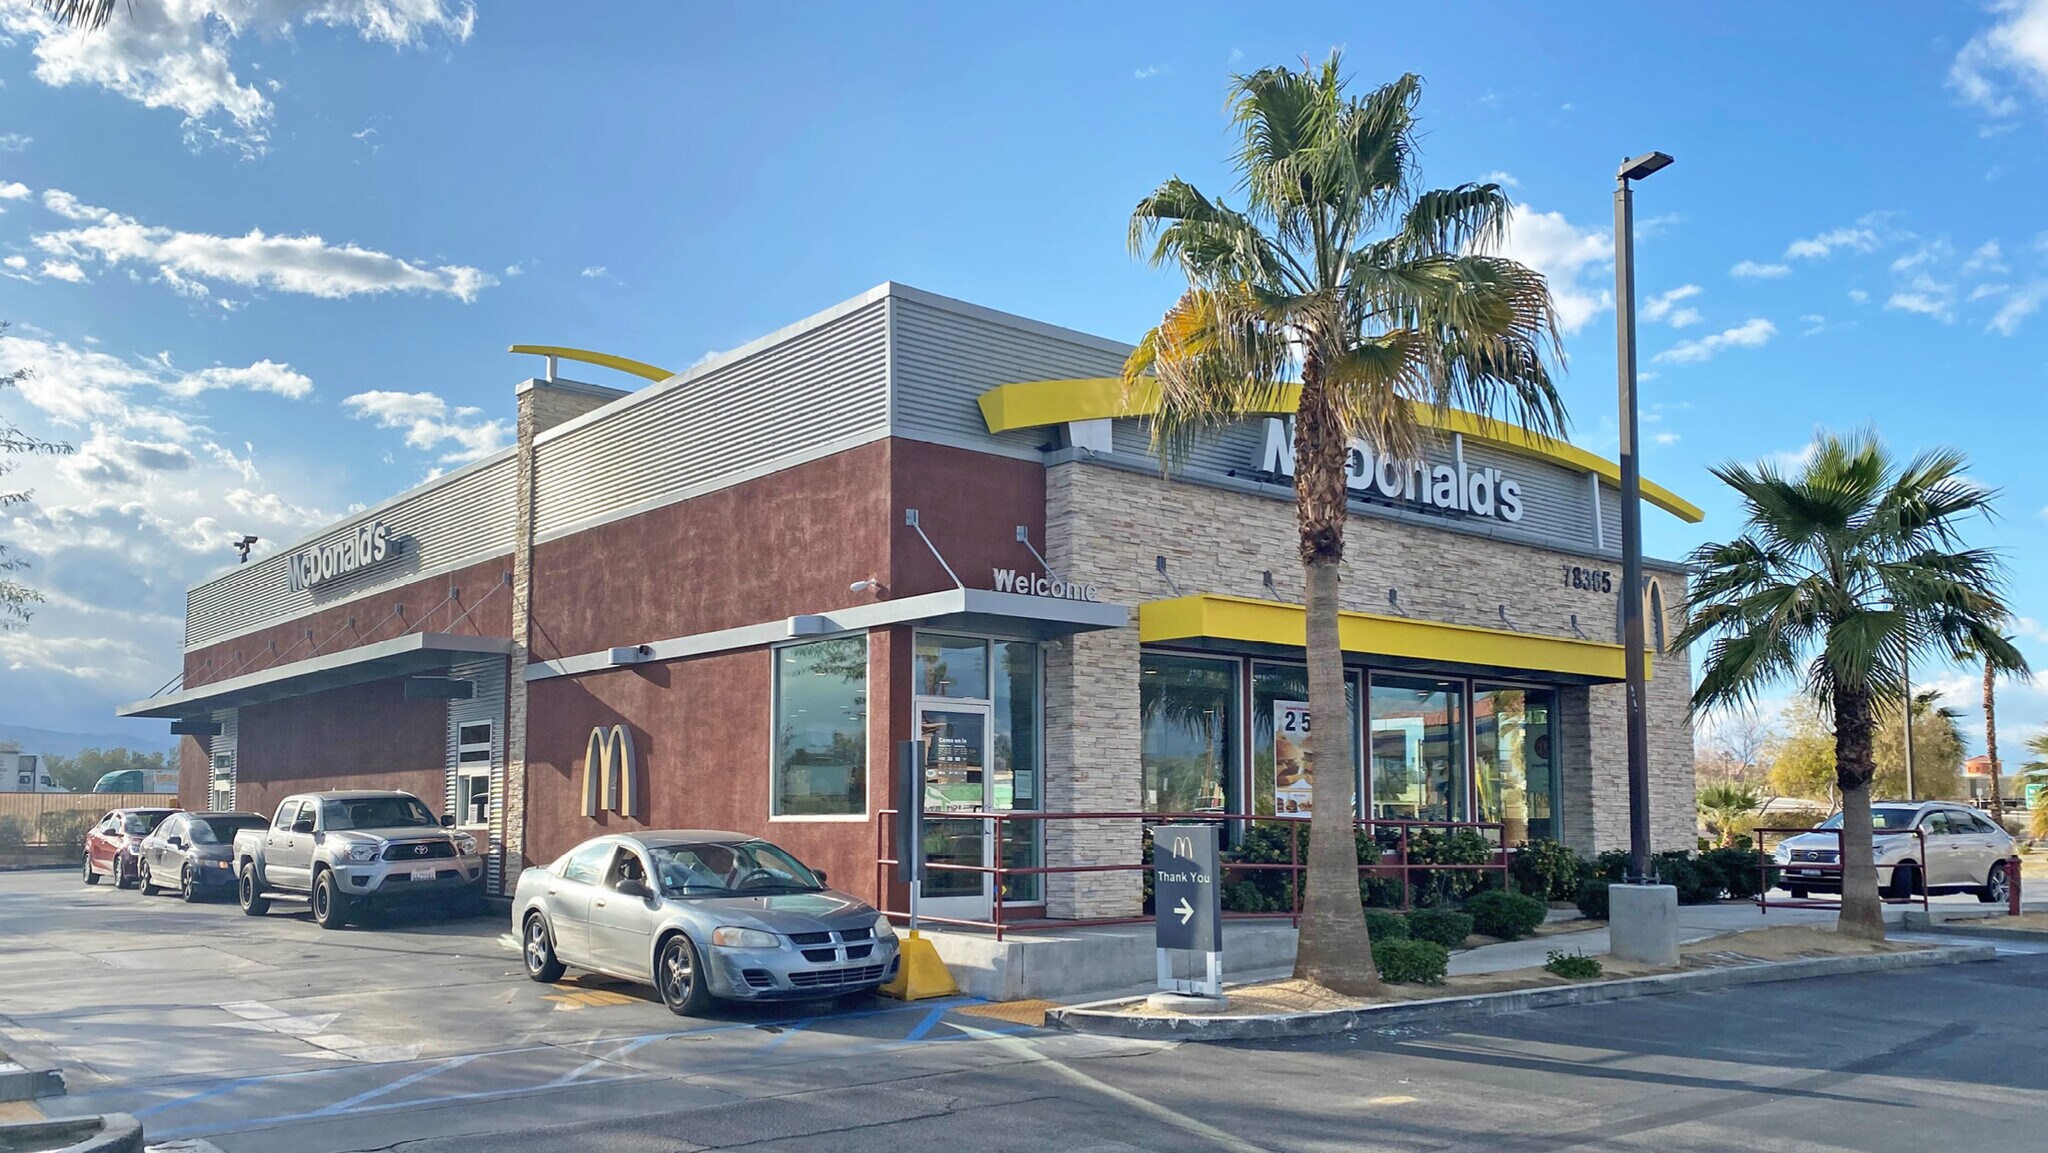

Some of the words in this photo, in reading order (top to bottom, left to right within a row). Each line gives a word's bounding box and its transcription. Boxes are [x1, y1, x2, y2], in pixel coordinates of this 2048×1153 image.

[1260, 416, 1524, 523] MDonald's
[286, 520, 387, 594] McDonald's
[992, 566, 1099, 602] Welcome
[1562, 564, 1612, 594] 78365
[1158, 870, 1188, 883] Thank
[1190, 871, 1210, 884] You
